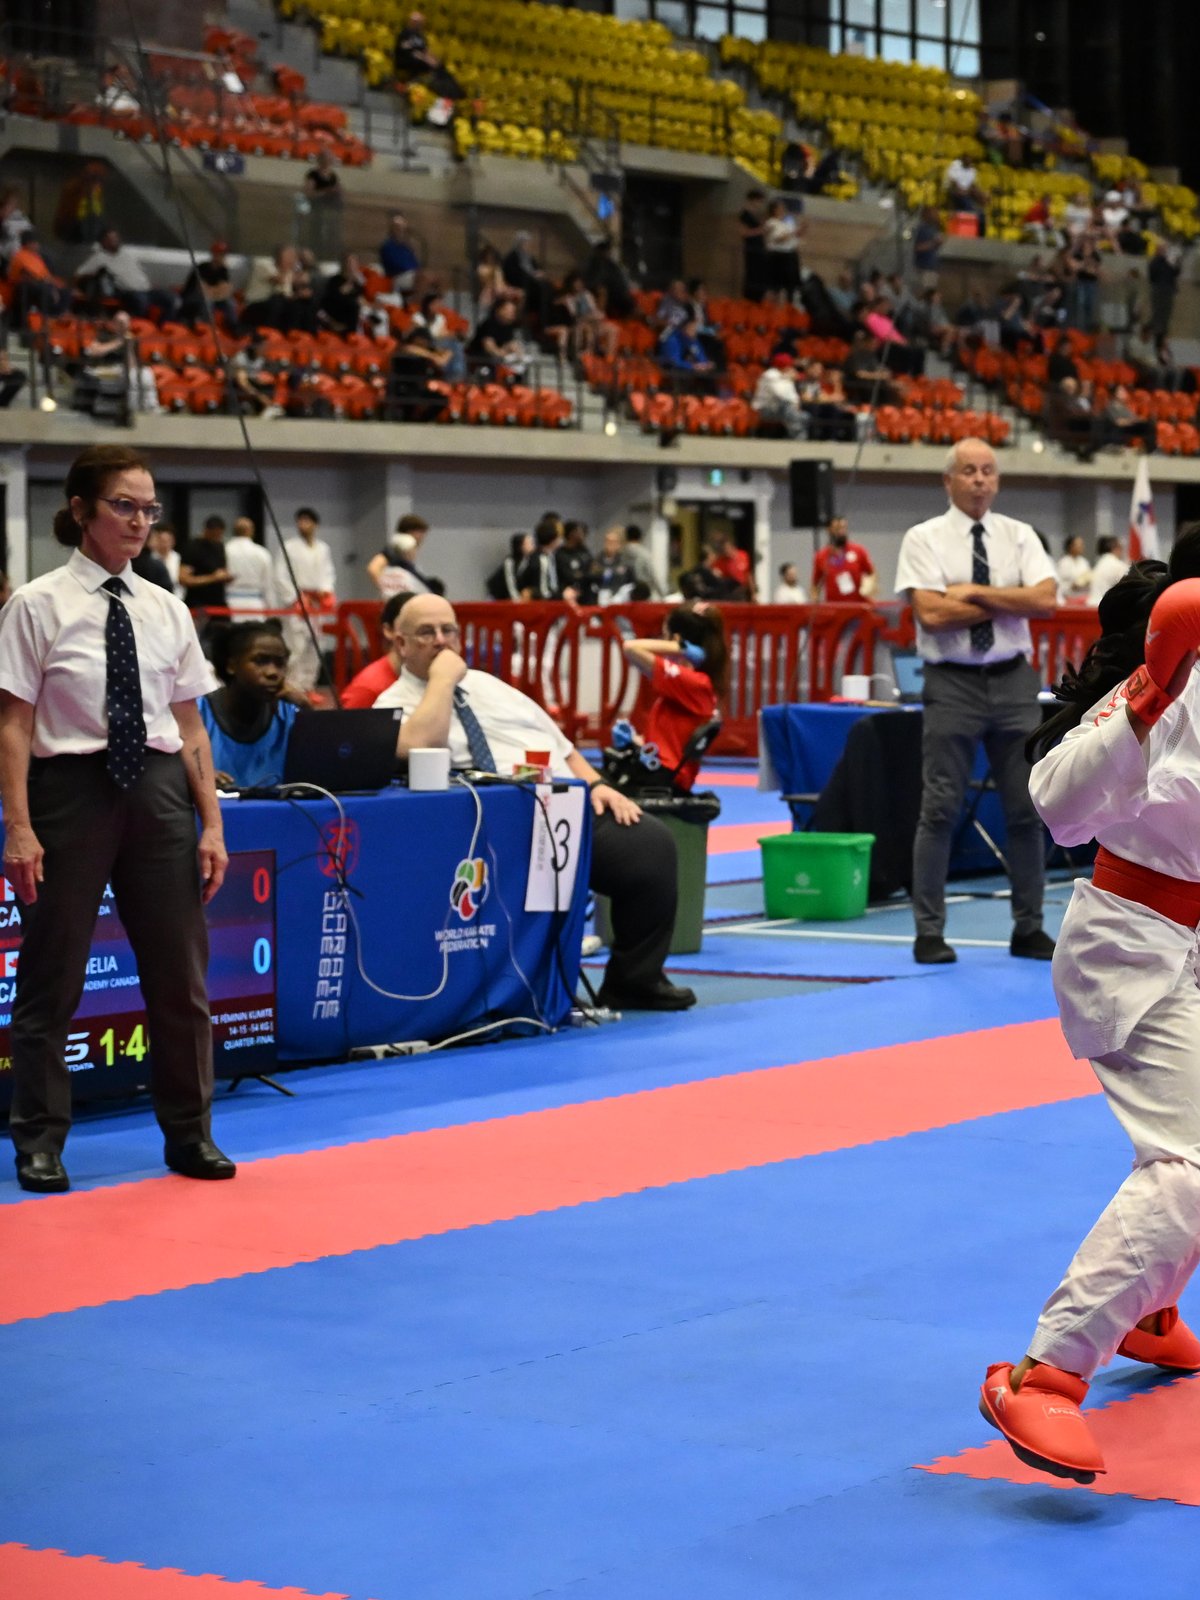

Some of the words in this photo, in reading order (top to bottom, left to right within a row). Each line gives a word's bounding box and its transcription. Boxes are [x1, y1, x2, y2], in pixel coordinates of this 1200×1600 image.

[551, 818, 570, 872] 3
[253, 867, 270, 904] 0
[253, 937, 271, 975] 0
[109, 975, 140, 988] CANADA
[99, 1023, 150, 1067] 1:4
